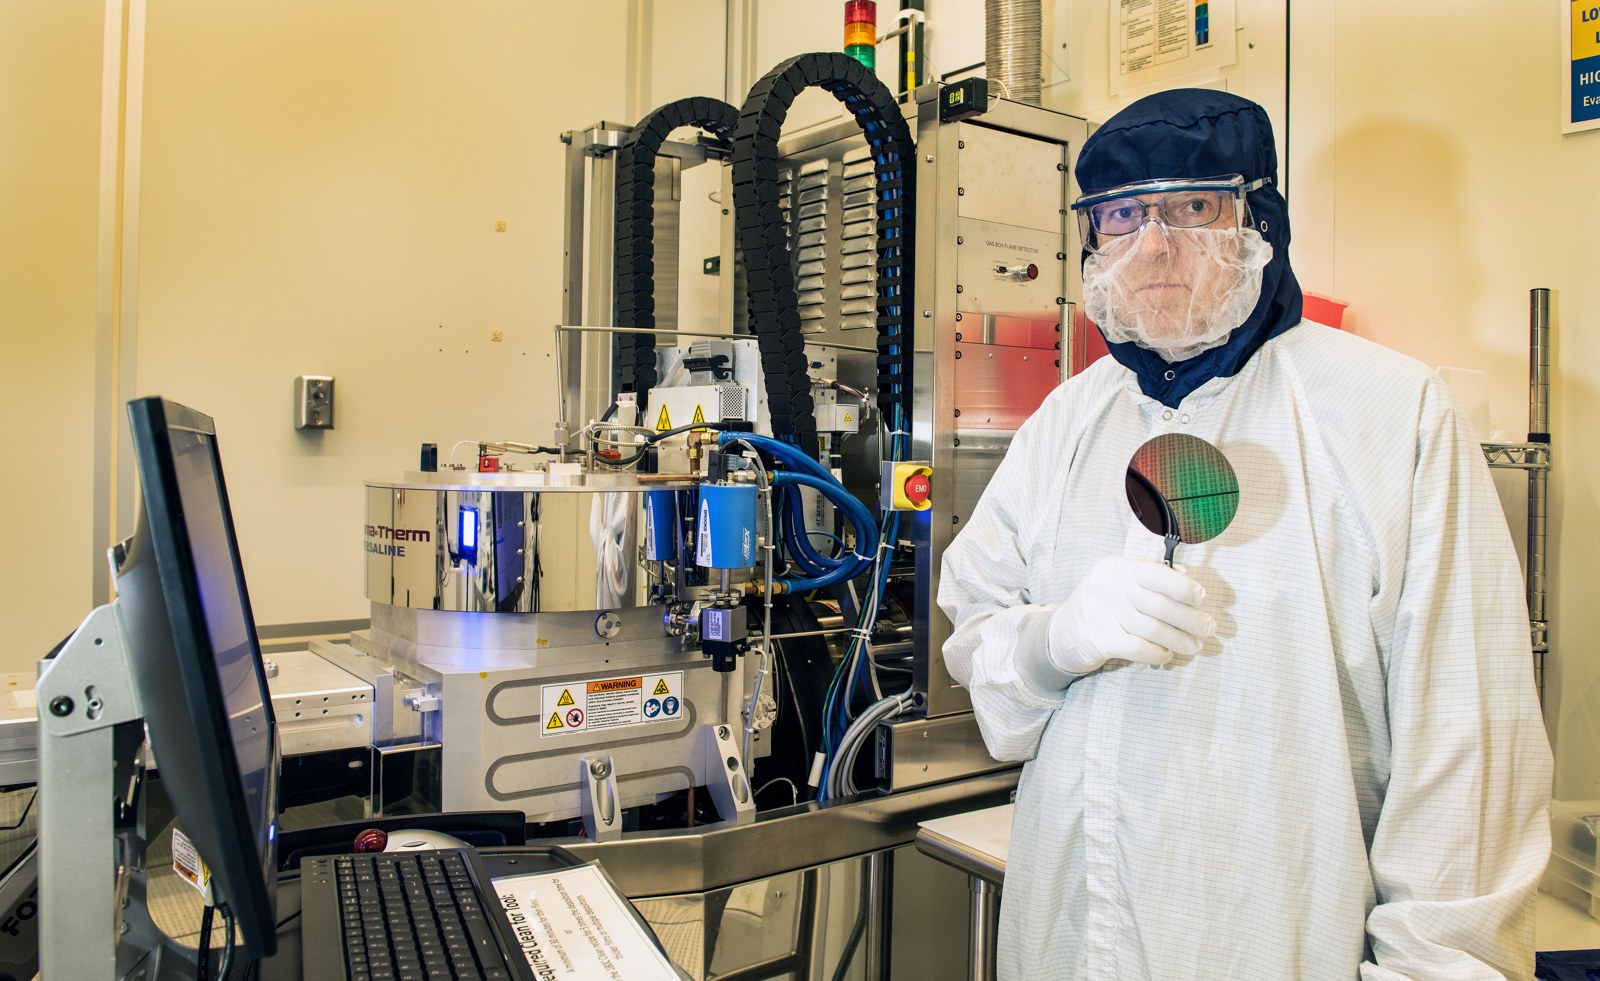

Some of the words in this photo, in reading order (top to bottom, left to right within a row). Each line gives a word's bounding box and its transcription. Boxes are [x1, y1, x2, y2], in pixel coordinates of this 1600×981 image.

[1018, 245, 1038, 254] DETECTOR
[915, 484, 927, 493] EMO
[601, 680, 637, 690] WARNING
[500, 894, 520, 912] Tool:
[511, 913, 525, 925] for
[517, 925, 538, 949] Clean
[529, 949, 557, 981] equired
